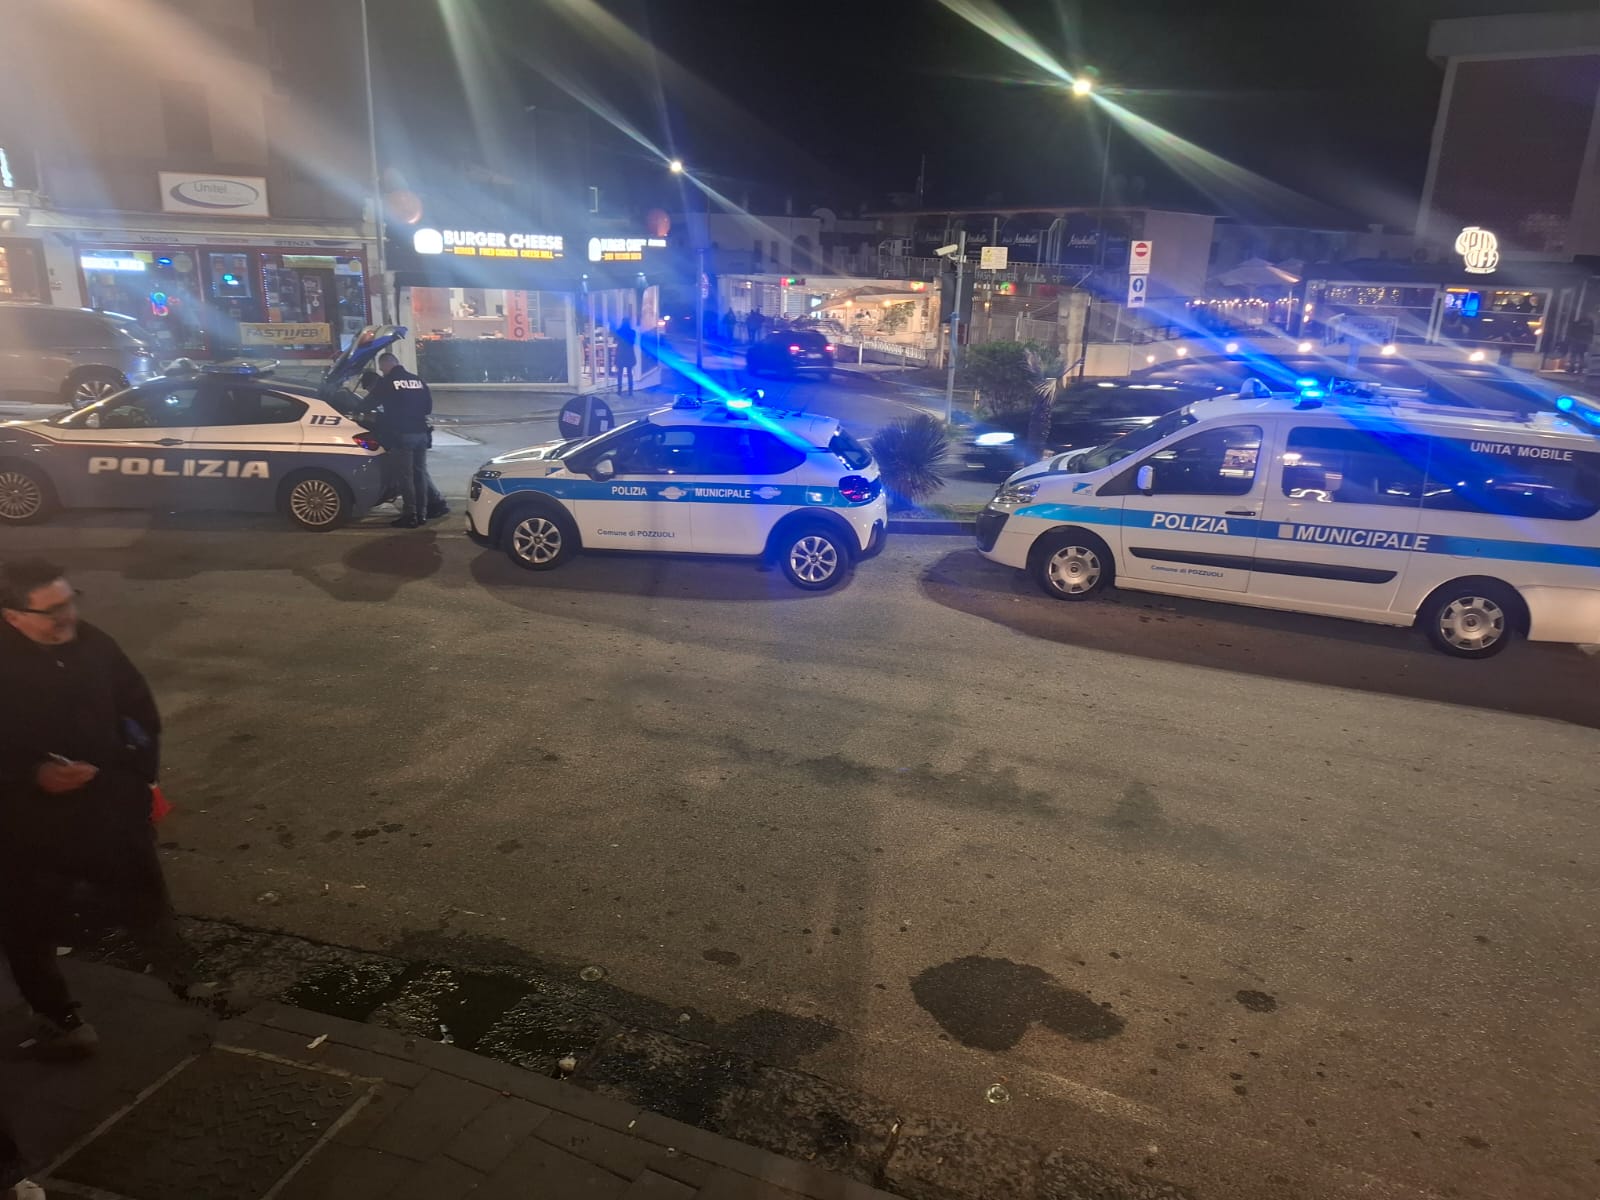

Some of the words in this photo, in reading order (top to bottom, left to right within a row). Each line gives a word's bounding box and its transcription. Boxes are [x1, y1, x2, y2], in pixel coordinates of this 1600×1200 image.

[193, 183, 228, 194] Unitel
[443, 230, 507, 247] BURGER
[508, 233, 563, 250] CHEESE
[310, 414, 342, 426] 113
[1517, 446, 1573, 461] MOBILE
[88, 456, 270, 478] POLIZIA
[611, 486, 648, 496] POLIZIA
[695, 487, 751, 499] MUNICIPALE
[597, 528, 627, 537] Comune
[1151, 513, 1229, 534] POLIZIA
[1296, 525, 1430, 551] MUNICIPALE
[1187, 568, 1224, 578] POZZUOLI
